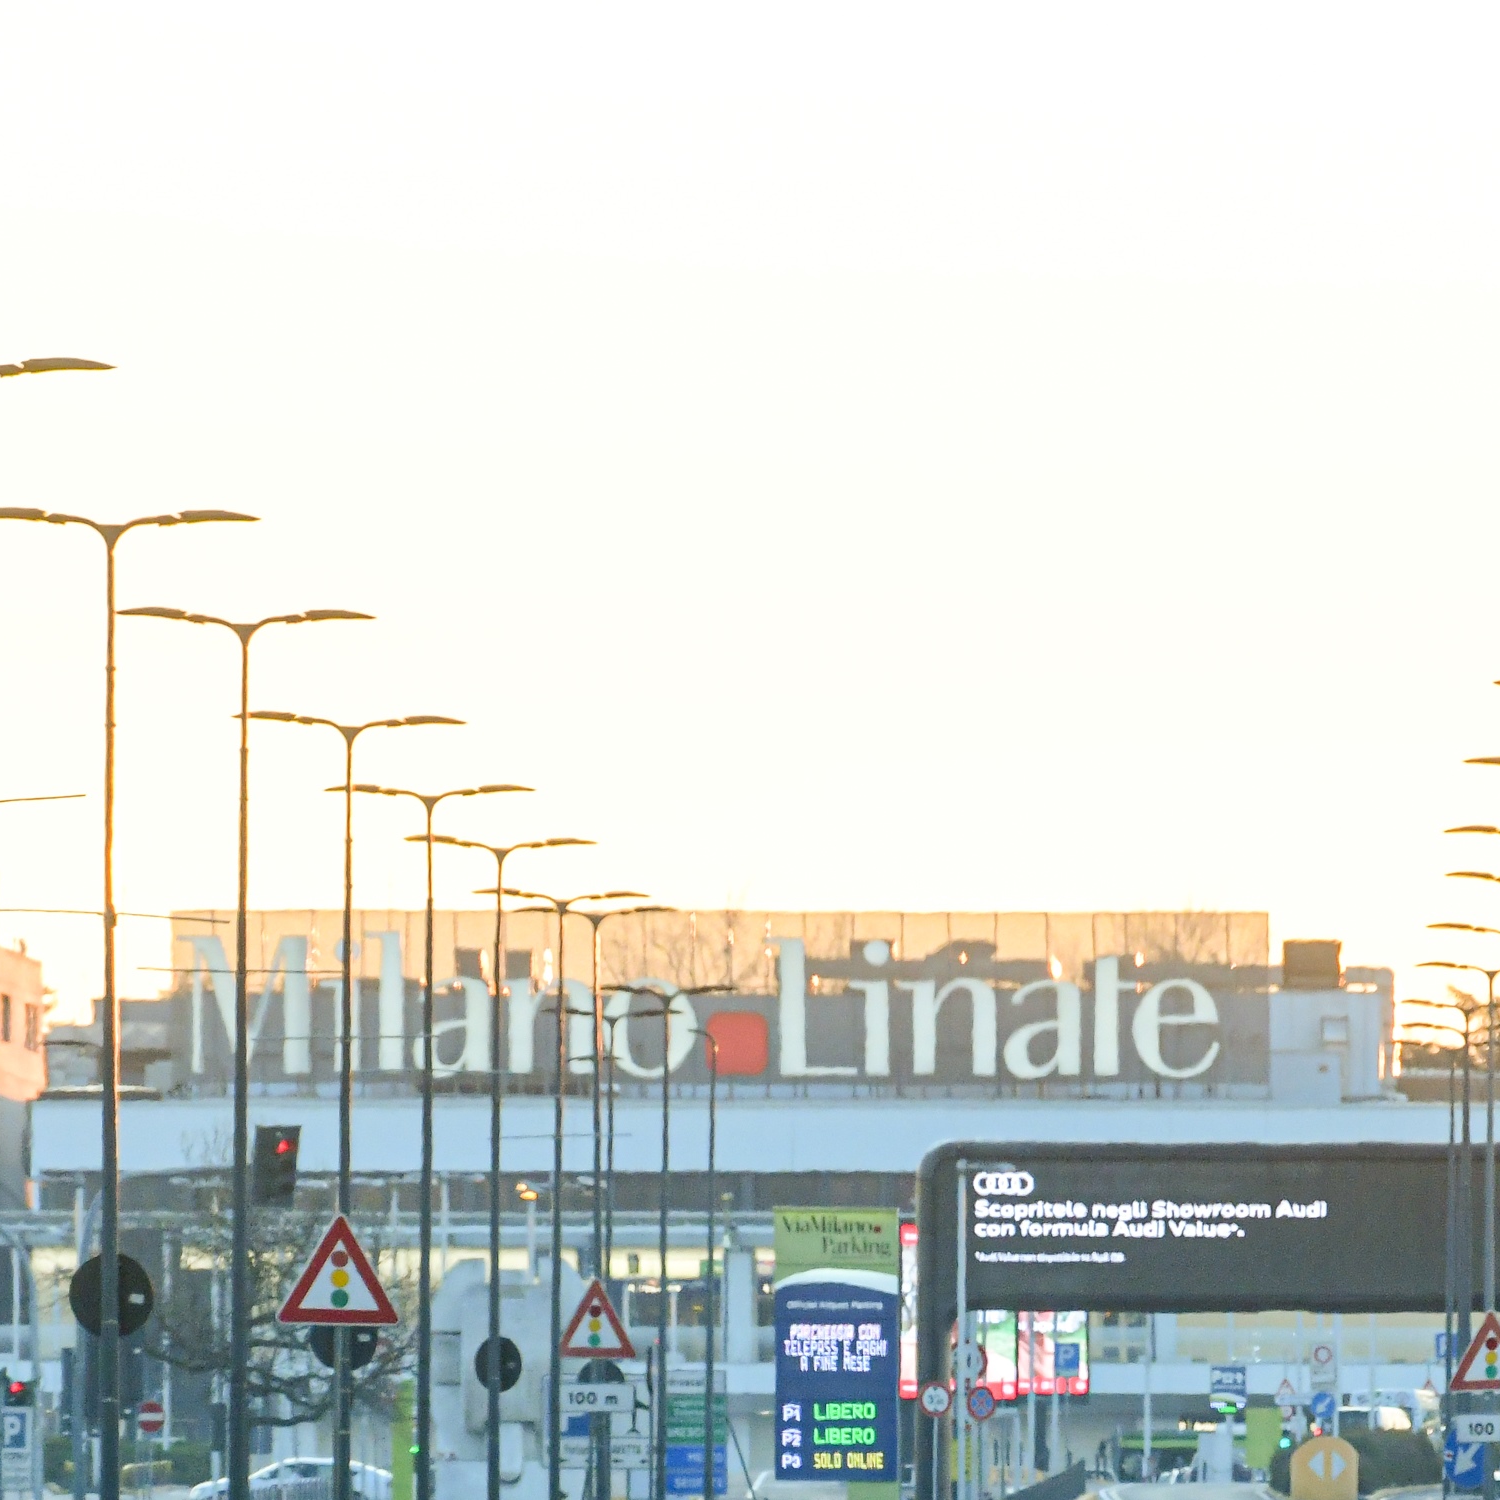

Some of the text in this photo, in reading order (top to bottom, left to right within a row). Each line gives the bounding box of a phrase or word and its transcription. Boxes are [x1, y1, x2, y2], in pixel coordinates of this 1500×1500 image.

[178, 931, 1219, 1080] Milano Linate
[974, 1199, 1327, 1221] Scopritele negli Showroom Audi
[974, 1222, 1016, 1237] con
[1020, 1219, 1109, 1237] formula
[1112, 1220, 1165, 1238] Audi
[568, 1392, 598, 1405] 100
[782, 1402, 876, 1421] P1 LIBERO
[781, 1427, 876, 1447] P2 LIBERO
[1468, 1422, 1494, 1436] 100
[813, 1453, 842, 1469] SOLO
[847, 1452, 883, 1469] ONLINE
